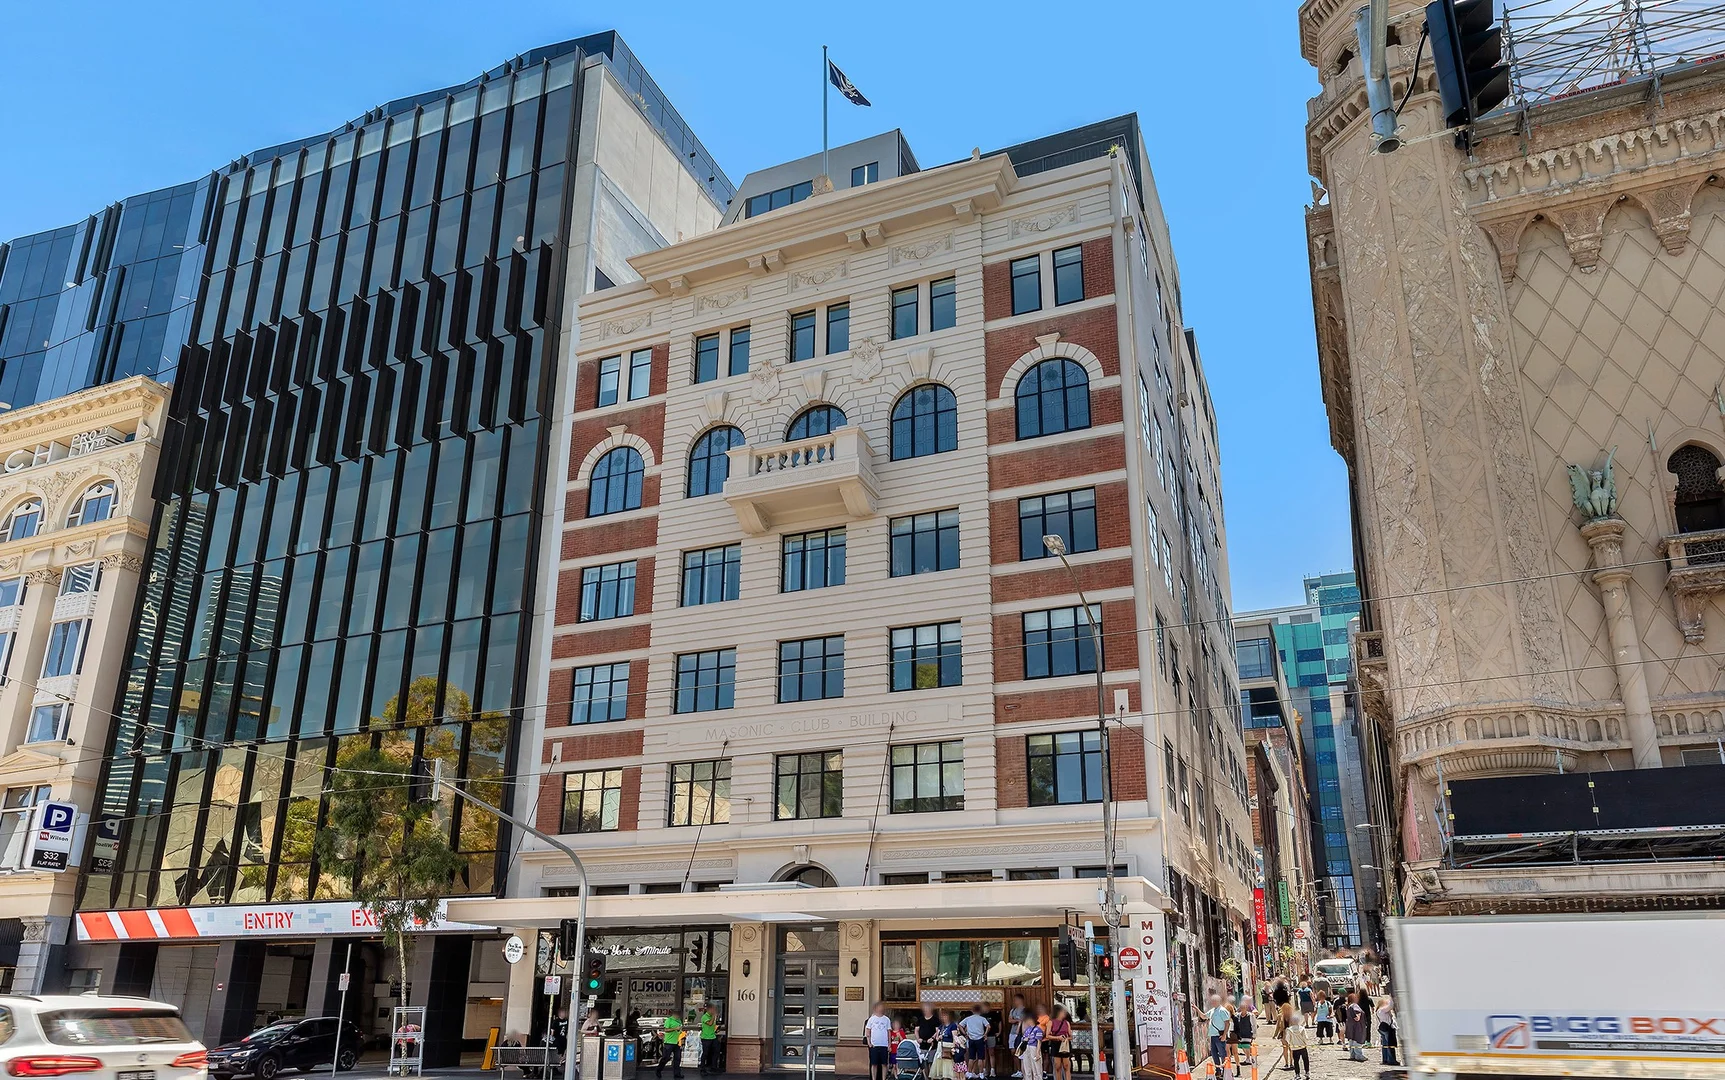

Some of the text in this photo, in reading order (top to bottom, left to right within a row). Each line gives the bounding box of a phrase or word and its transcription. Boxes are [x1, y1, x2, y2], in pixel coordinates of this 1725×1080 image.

[1597, 80, 1622, 90] ACCESS
[705, 710, 918, 741] MASONIC CLUB BUILDING
[50, 809, 67, 826] P
[49, 834, 69, 842] Wilson
[43, 851, 60, 861] $32
[244, 911, 294, 930] ENTRY
[1255, 898, 1263, 935] MOVIDA
[589, 944, 672, 956] New York Minute
[1141, 920, 1158, 1006] MOVIDA
[736, 988, 756, 1001] 166
[1531, 1016, 1622, 1033] BIGG
